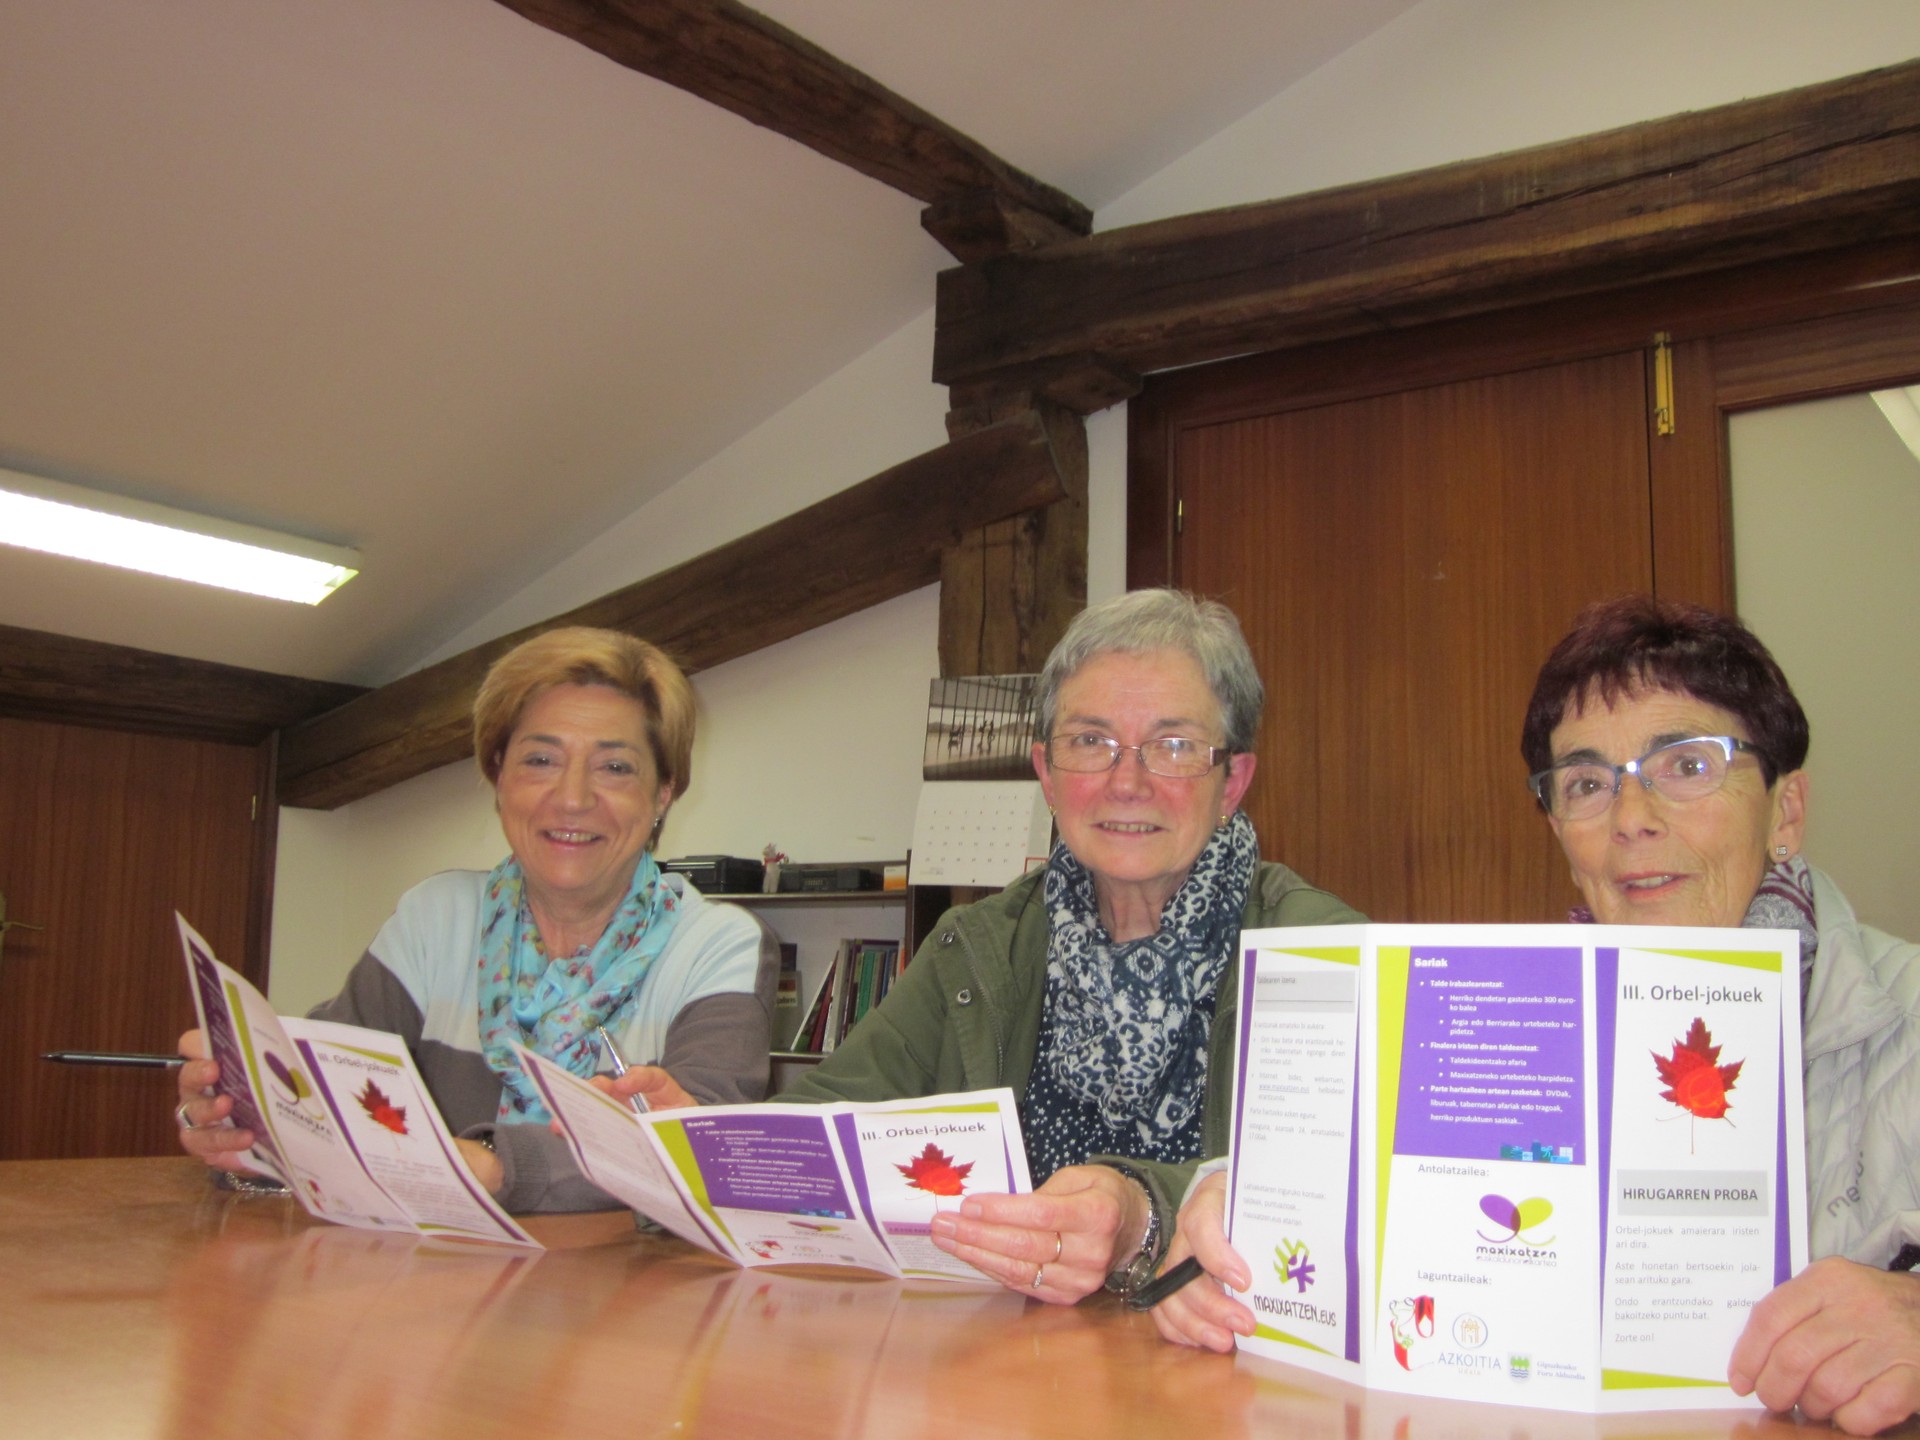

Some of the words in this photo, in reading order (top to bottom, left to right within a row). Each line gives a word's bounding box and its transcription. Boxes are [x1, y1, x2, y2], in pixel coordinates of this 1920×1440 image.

[1414, 958, 1448, 968] Sariak
[1430, 980, 1448, 988] Talde
[1450, 980, 1504, 988] irabazlearentzat:
[1475, 994, 1506, 1002] dendetan
[1507, 996, 1542, 1004] gastatzeko
[1623, 985, 1644, 1000] III.
[1651, 985, 1763, 1005] Orbel-jokuek
[1452, 1018, 1468, 1028] Argia
[1486, 1019, 1520, 1027] Berriarako
[1523, 1020, 1560, 1028] urtebeteko
[1450, 1028, 1476, 1037] pidetza.
[1498, 1044, 1540, 1052] taldeentzat:
[1450, 1057, 1507, 1066] Taldekideentzako
[1508, 1058, 1526, 1066] afaria
[1450, 1071, 1498, 1080] Maxixatzeneko
[1500, 1073, 1536, 1082] urtebeteko
[1538, 1074, 1576, 1084] harpidetza.
[1430, 1085, 1448, 1093] Parte
[1450, 1085, 1486, 1094] hartzaileen
[1487, 1087, 1510, 1095] artean
[1511, 1087, 1542, 1096] zozketak:
[1546, 1089, 1572, 1098] DVDak,
[1430, 1099, 1458, 1108] liburuak,
[1460, 1101, 1496, 1109] tabernetan
[1498, 1102, 1520, 1110] afariak
[1536, 1104, 1563, 1112] tragoak,
[1430, 1114, 1454, 1122] herriko
[1455, 1115, 1494, 1124] produktuen
[862, 1131, 882, 1141] III.
[886, 1122, 986, 1139] Orbel-jokuek
[1418, 1163, 1490, 1177] Antolatzailea:
[1623, 1188, 1710, 1200] HIRUGARREN
[1714, 1189, 1758, 1200] PROBA
[1615, 1226, 1674, 1236] Orbel-jokuek
[1681, 1227, 1726, 1236] amaierara
[1732, 1226, 1760, 1236] iristen
[1616, 1240, 1628, 1248] ari
[1630, 1240, 1650, 1248] dira.
[1476, 1245, 1557, 1260] maxixatzen
[1615, 1261, 1634, 1270] Aste
[1642, 1261, 1679, 1270] honetan
[1686, 1262, 1734, 1270] bertsoekin
[1740, 1262, 1760, 1273] jola-
[1418, 1270, 1492, 1285] Laguntzaileak:
[1638, 1274, 1669, 1284] arituko
[1671, 1276, 1694, 1286] gara.
[1615, 1297, 1639, 1306] Ondo
[1652, 1297, 1713, 1306] erantzundako
[1254, 1294, 1337, 1327] MAXIXATZEN.EUS
[1615, 1311, 1661, 1320] bakoitzeko
[1663, 1312, 1690, 1322] puntu
[1692, 1312, 1710, 1320] bat.
[1615, 1334, 1638, 1342] Zorte
[1640, 1334, 1655, 1342] on!
[1438, 1352, 1502, 1370] AZKOITIA
